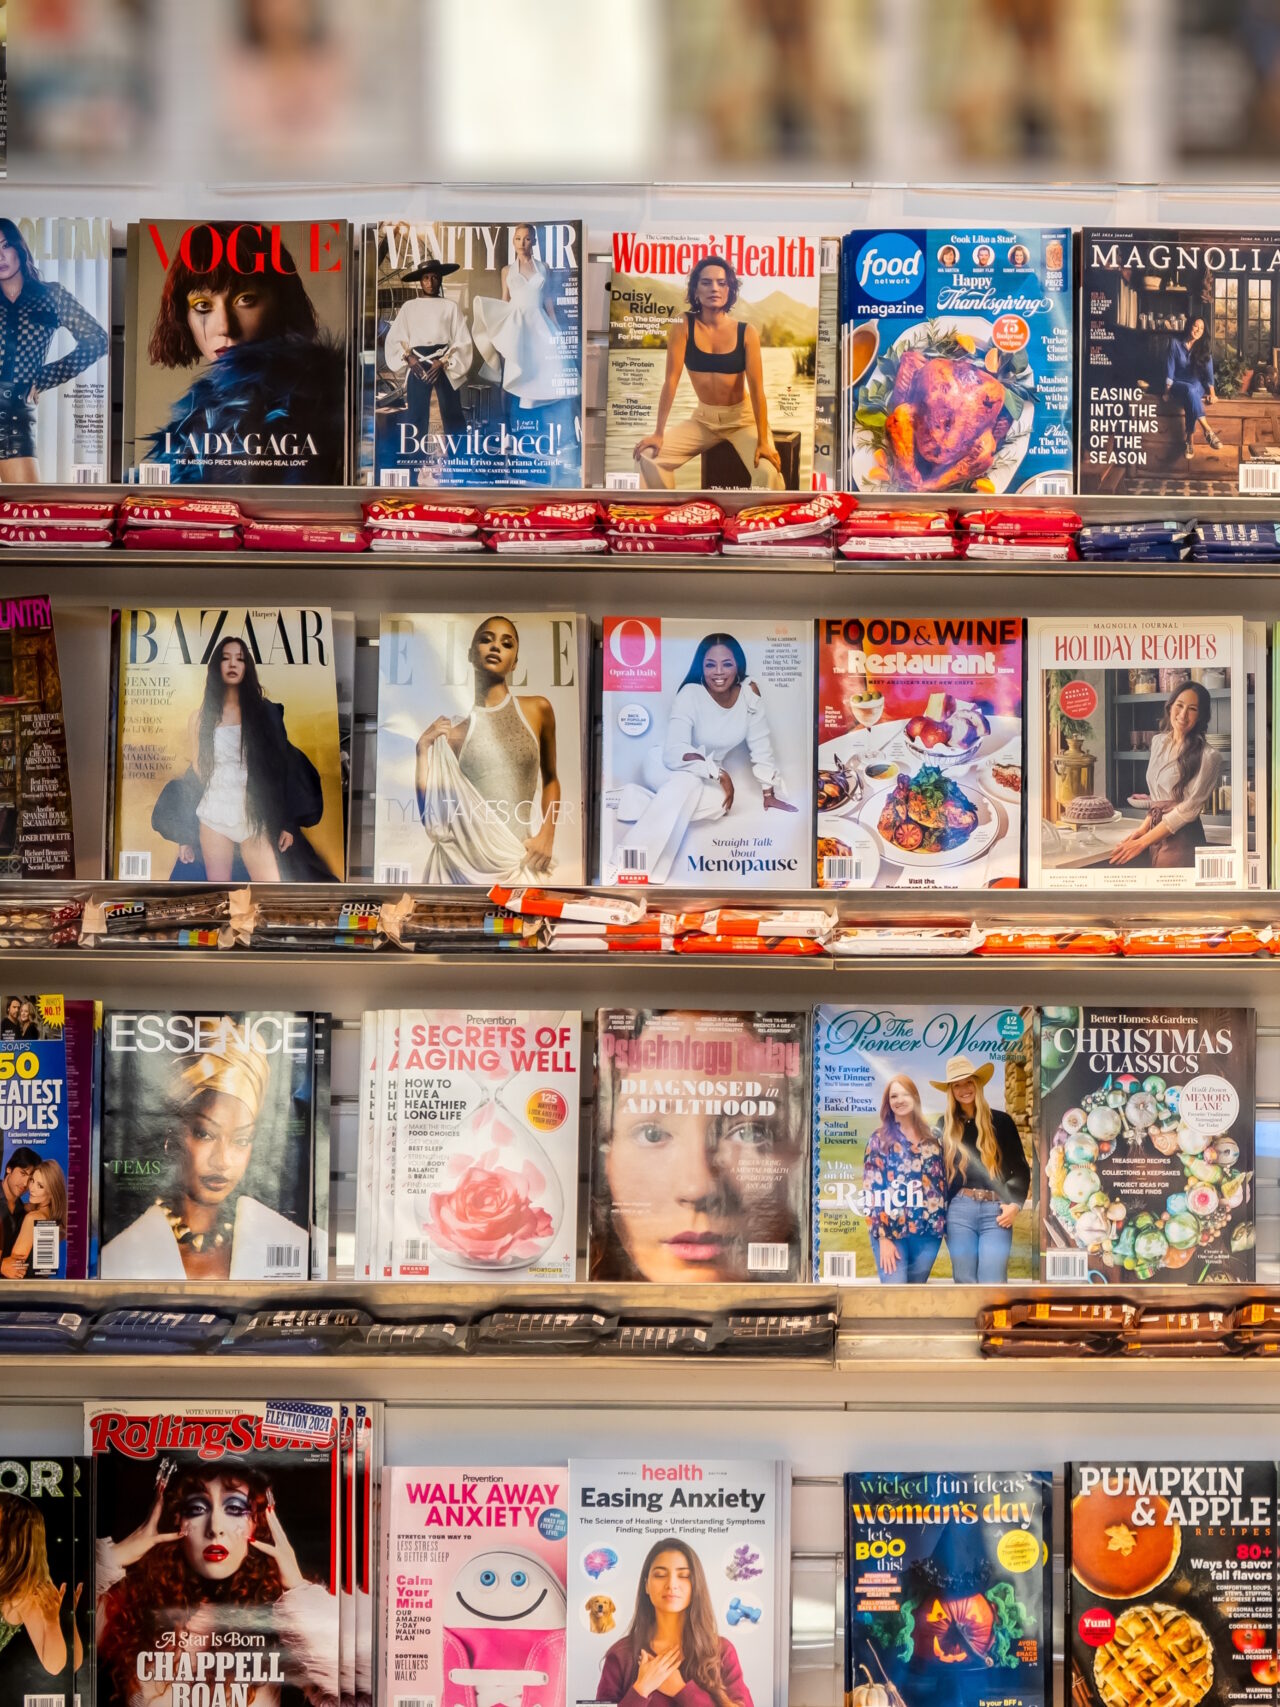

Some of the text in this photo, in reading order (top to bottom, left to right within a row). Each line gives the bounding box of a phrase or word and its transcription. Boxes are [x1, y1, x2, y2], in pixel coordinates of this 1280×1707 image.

[148, 223, 341, 275] VOGUE
[384, 225, 501, 270] VANITY
[724, 234, 815, 277] Health
[860, 249, 922, 286] food
[612, 290, 652, 304] Daisy
[937, 288, 1053, 317] Thanksgiving
[630, 302, 674, 316] Ridley
[858, 303, 924, 317] magazine
[1091, 388, 1143, 400] EASING
[1091, 404, 1157, 417] INTO THE
[1091, 420, 1158, 433] RHYTHMS
[165, 432, 318, 455] LADY GAGA
[396, 422, 561, 456] Bewitched!
[1090, 435, 1142, 448] OF THE
[1090, 452, 1147, 465] SEASON
[128, 609, 330, 666] BAZAAR
[825, 620, 1016, 646] FOOD & WINE
[1055, 634, 1217, 661] HOLIDAY RECIPES
[848, 652, 995, 674] Restaurant
[712, 838, 772, 848] Straight Talk
[730, 849, 756, 858] About
[687, 855, 798, 875] Menopause
[466, 1014, 516, 1026] Prevention
[111, 1015, 308, 1054] ESSENCE
[411, 1025, 570, 1048] SECRETS OF
[1054, 1028, 1233, 1054] CHRISTMAS
[404, 1049, 576, 1072] AGING WELL
[1089, 1054, 1199, 1074] CLASSICS
[620, 1079, 779, 1097] DIAGNOSED in
[623, 1098, 776, 1117] ADULTHOOD
[824, 1121, 849, 1129] Salted
[824, 1129, 857, 1137] Caramel
[824, 1137, 858, 1145] Desserts
[112, 1159, 161, 1175] TEMS
[824, 1173, 923, 1217] Ranch
[642, 1464, 703, 1481] health
[1079, 1467, 1244, 1496] PUMPKIN
[406, 1484, 560, 1505] WALK AWAY
[581, 1488, 765, 1513] Easing Anxiety
[425, 1506, 540, 1527] ANXIETY
[852, 1494, 1036, 1530] woman's day
[1131, 1497, 1271, 1526] & APPLE
[1196, 1528, 1271, 1536] RECIPES
[856, 1538, 906, 1560] BOO
[397, 1575, 433, 1586] Calm
[397, 1587, 429, 1597] Your
[397, 1599, 433, 1608] Mind
[156, 1632, 265, 1648] A Star Is Born
[136, 1651, 285, 1682] CHAPPELL
